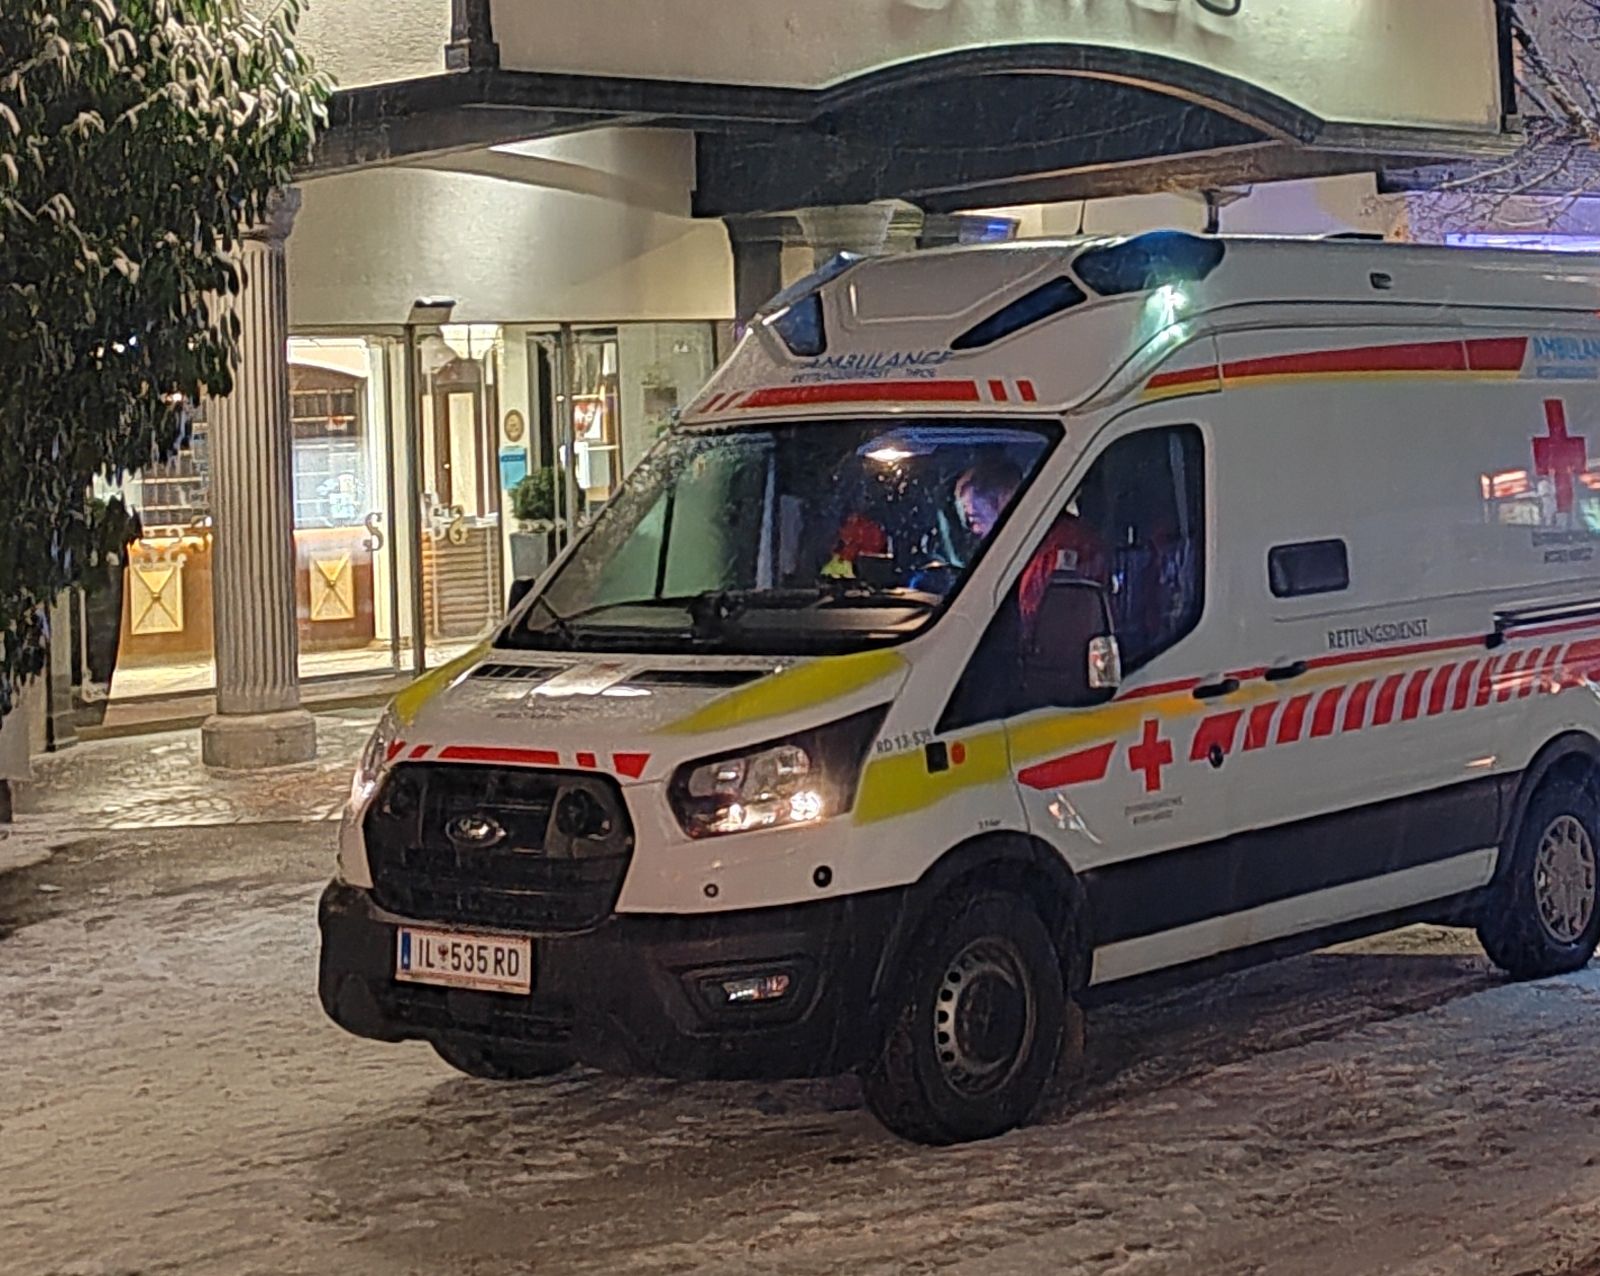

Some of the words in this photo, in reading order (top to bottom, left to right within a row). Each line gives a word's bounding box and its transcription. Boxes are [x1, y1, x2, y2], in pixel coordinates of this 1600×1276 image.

[800, 350, 956, 373] AMBULANCE
[1327, 618, 1428, 650] RETTUNGSDIENST
[876, 739, 893, 754] RD
[418, 938, 435, 968] IL
[451, 942, 489, 974] 535
[493, 947, 520, 977] RD
